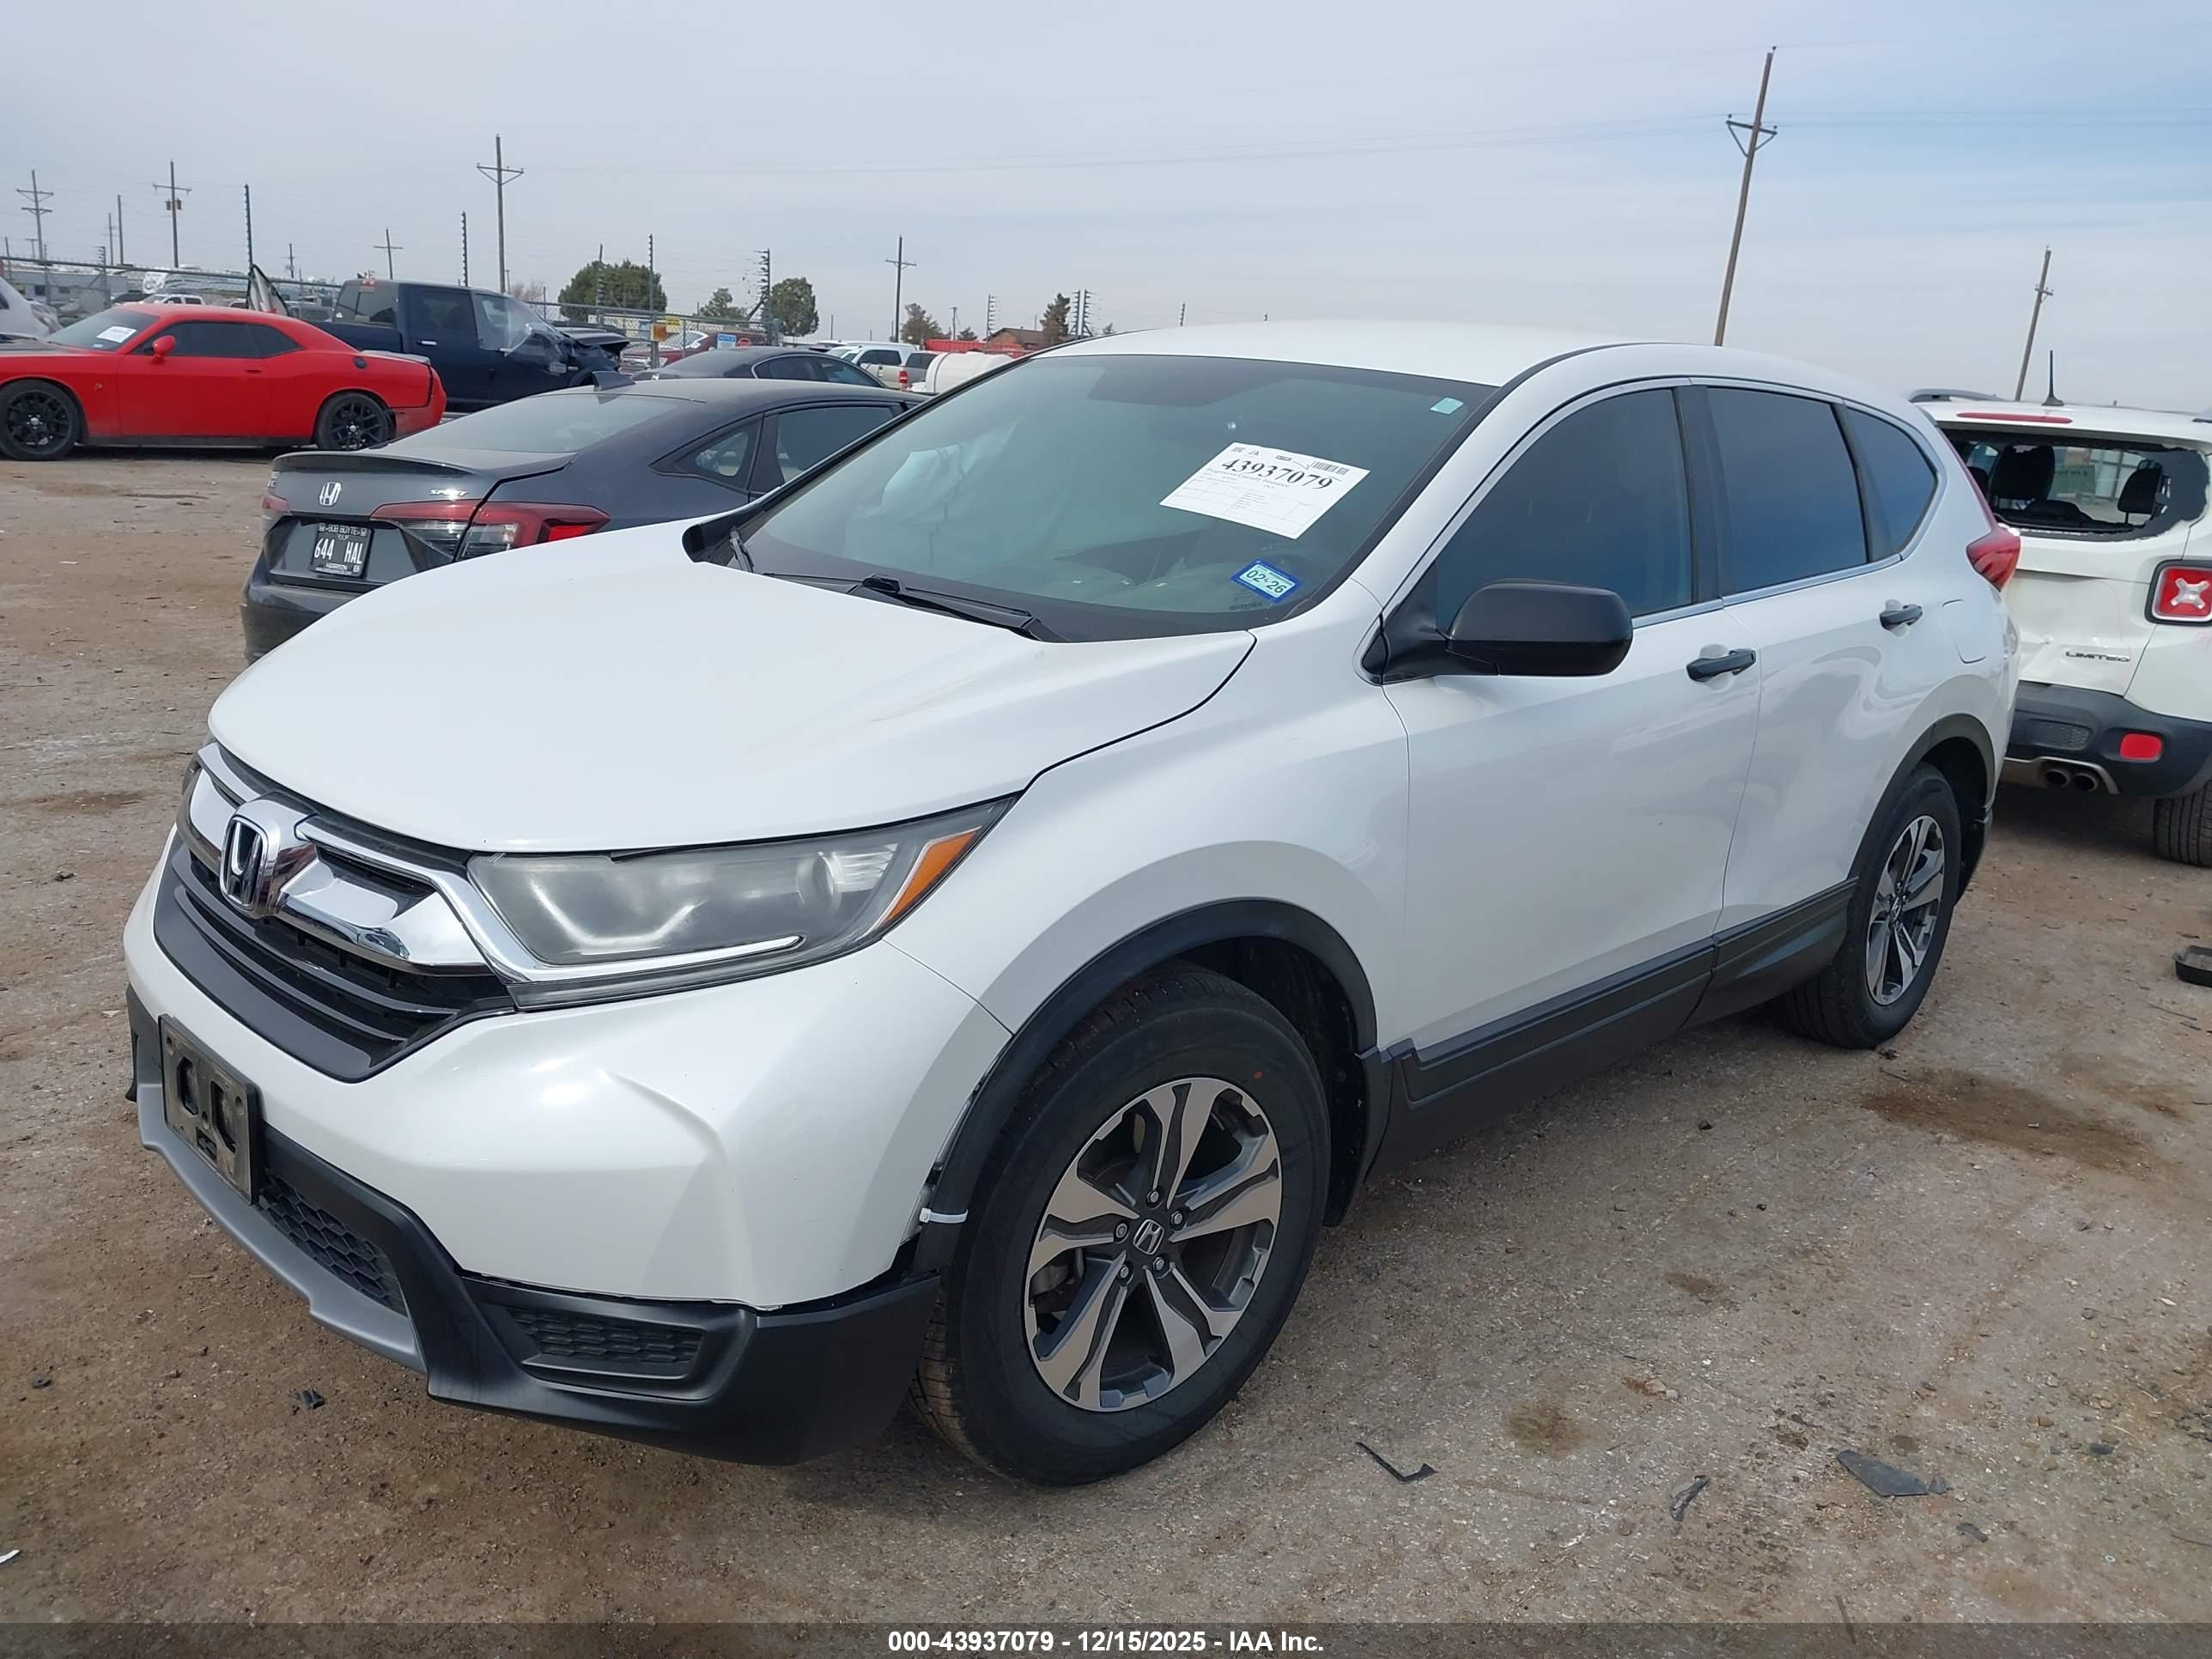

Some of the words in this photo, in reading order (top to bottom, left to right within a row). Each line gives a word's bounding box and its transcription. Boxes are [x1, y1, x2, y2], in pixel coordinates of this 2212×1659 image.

[1222, 459, 1333, 489] 43937079
[314, 538, 335, 560] 644
[343, 541, 363, 564] HAL
[1246, 569, 1266, 582] 02
[1266, 580, 1287, 593] 26
[2065, 651, 2130, 662] LIMITED
